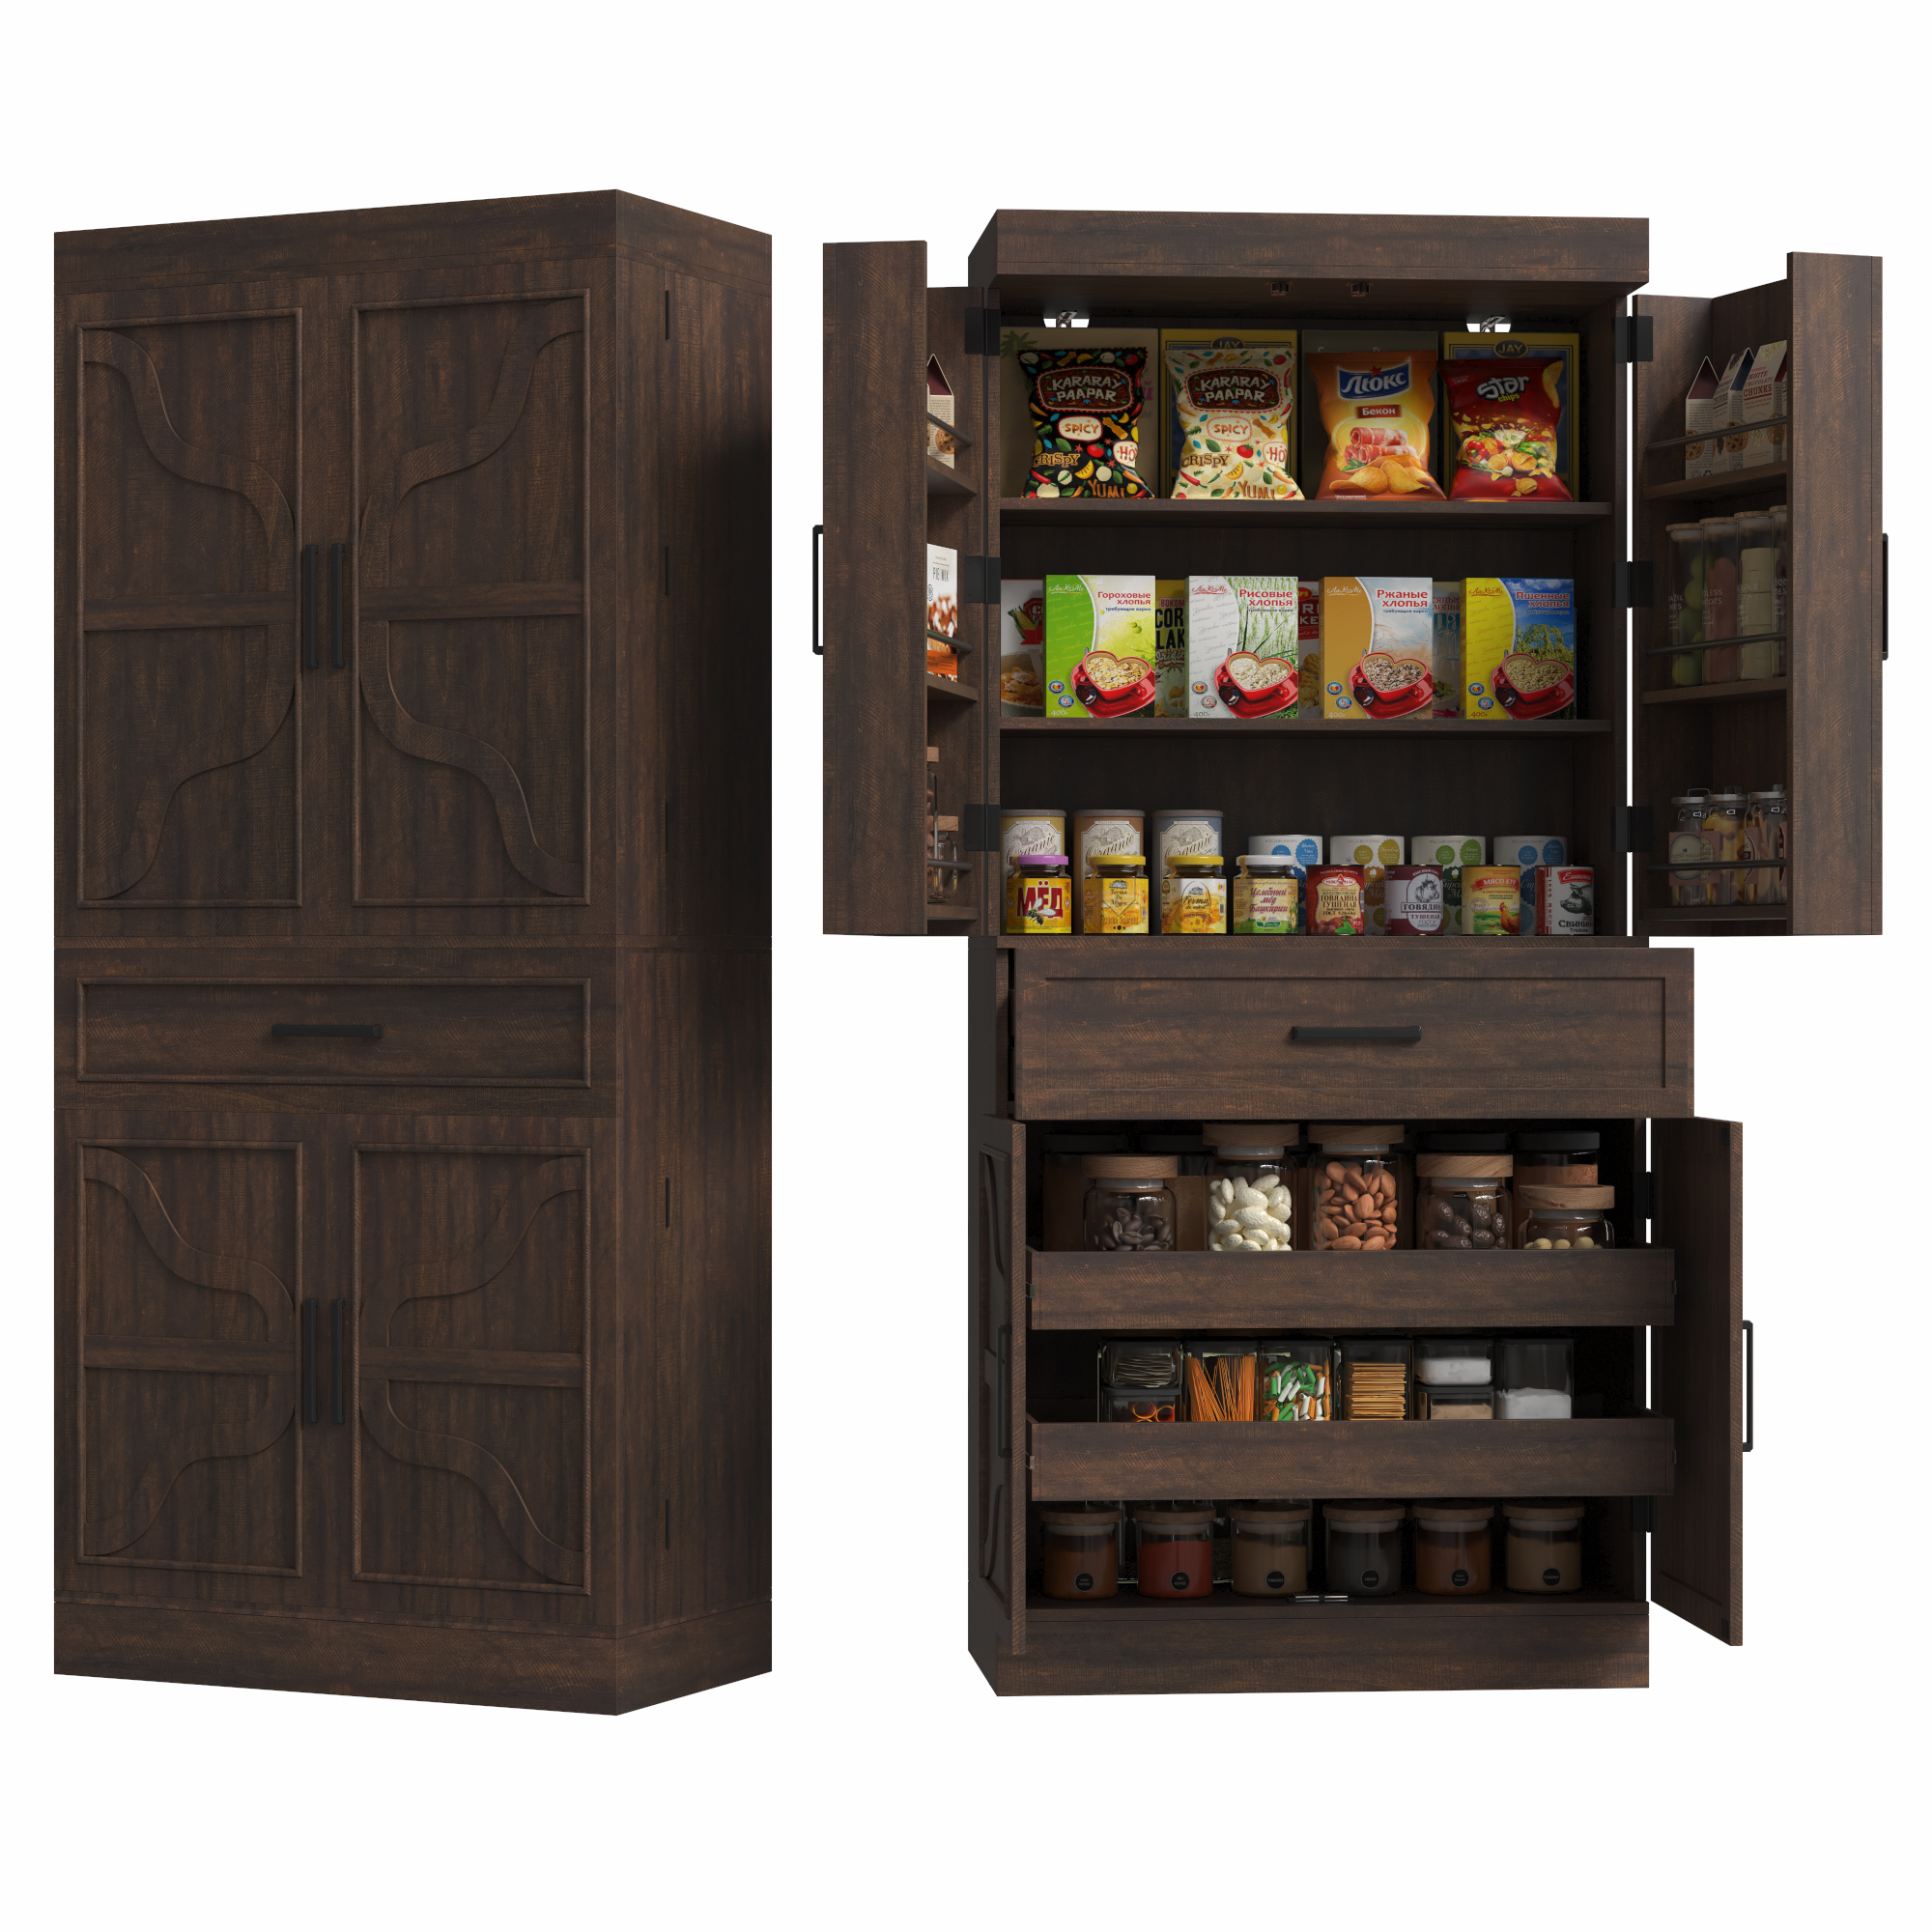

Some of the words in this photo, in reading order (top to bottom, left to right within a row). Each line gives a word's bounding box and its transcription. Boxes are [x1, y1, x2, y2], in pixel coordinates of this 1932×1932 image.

[1497, 344, 1523, 354] JAY
[1052, 375, 1122, 391] KARARAY
[1200, 376, 1270, 391] KARARAY
[1341, 372, 1407, 395] Люкс
[1056, 388, 1117, 402] PAAPAR
[1205, 388, 1265, 403] PAAPAR
[1743, 384, 1773, 397] CHUNKS
[1497, 392, 1521, 403] chips
[1361, 407, 1396, 416] Бекон
[1065, 423, 1098, 434] SPICY
[1213, 424, 1248, 435] SPICY
[1033, 452, 1081, 468] CRISPY
[1181, 453, 1230, 469] CRISPY
[1097, 591, 1151, 600] Гороховые
[1239, 589, 1293, 598] Рисовые
[1377, 589, 1428, 599] Ржаные
[1516, 591, 1570, 600] Пшенные
[1160, 599, 1185, 608] BOKOM
[1155, 608, 1184, 629] COR
[1155, 629, 1185, 650] LAK
[1007, 832, 1056, 863] Organic
[1086, 833, 1135, 863] Organic
[1165, 833, 1212, 860] Organic
[1250, 887, 1288, 898] Целебный
[1017, 880, 1064, 919] МЁД
[1249, 903, 1289, 915] Башкирии
